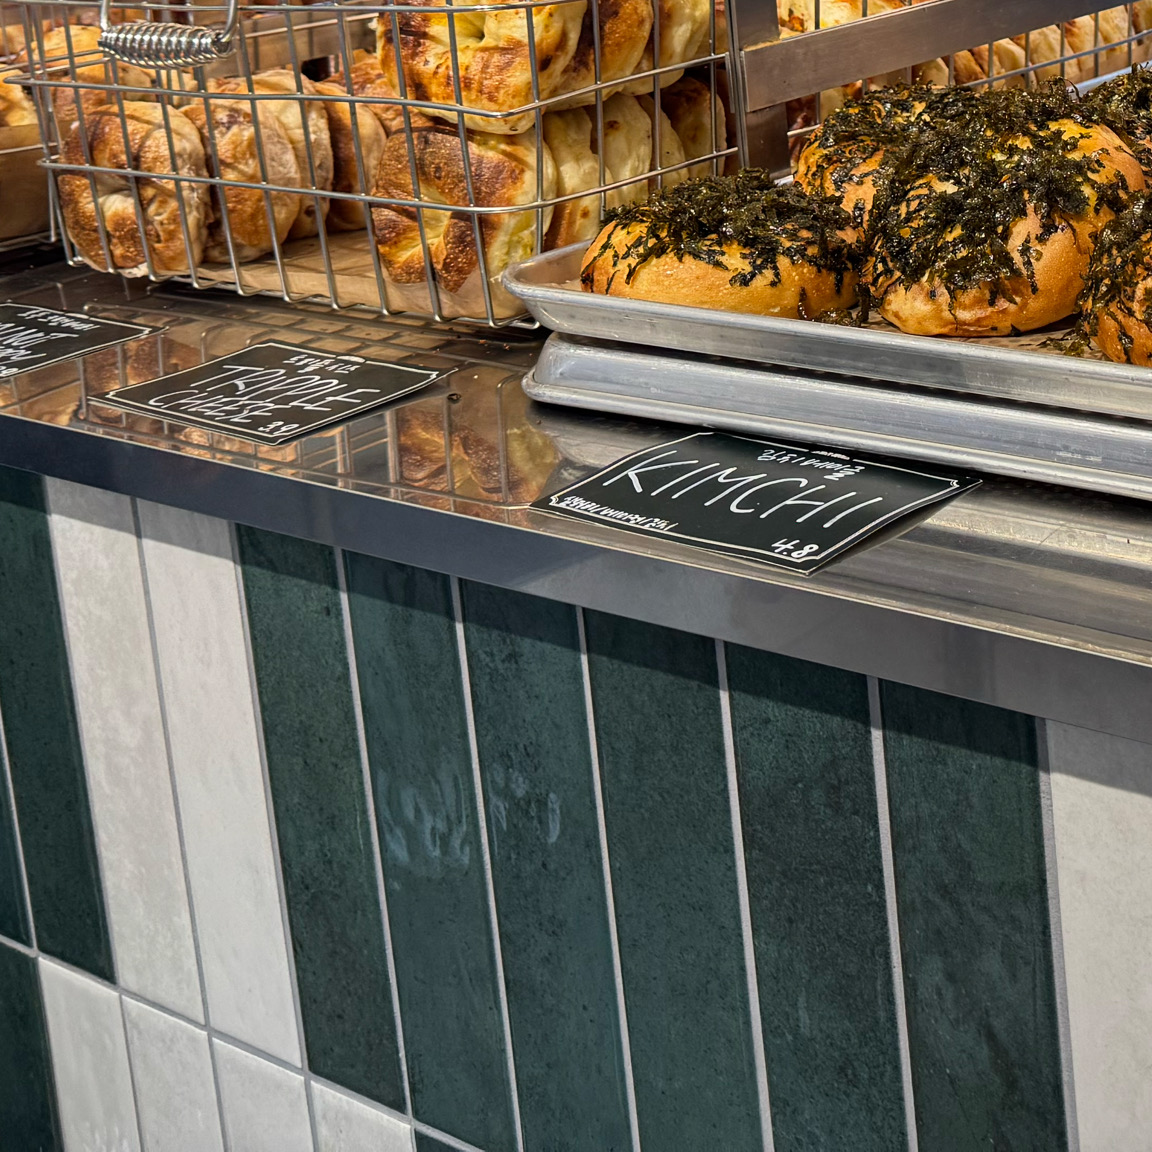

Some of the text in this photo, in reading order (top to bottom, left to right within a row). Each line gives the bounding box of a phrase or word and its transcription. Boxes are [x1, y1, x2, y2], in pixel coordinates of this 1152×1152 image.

[148, 389, 292, 423] CHEESE
[602, 449, 884, 529] KIMCHI
[771, 538, 820, 559] 4.8
